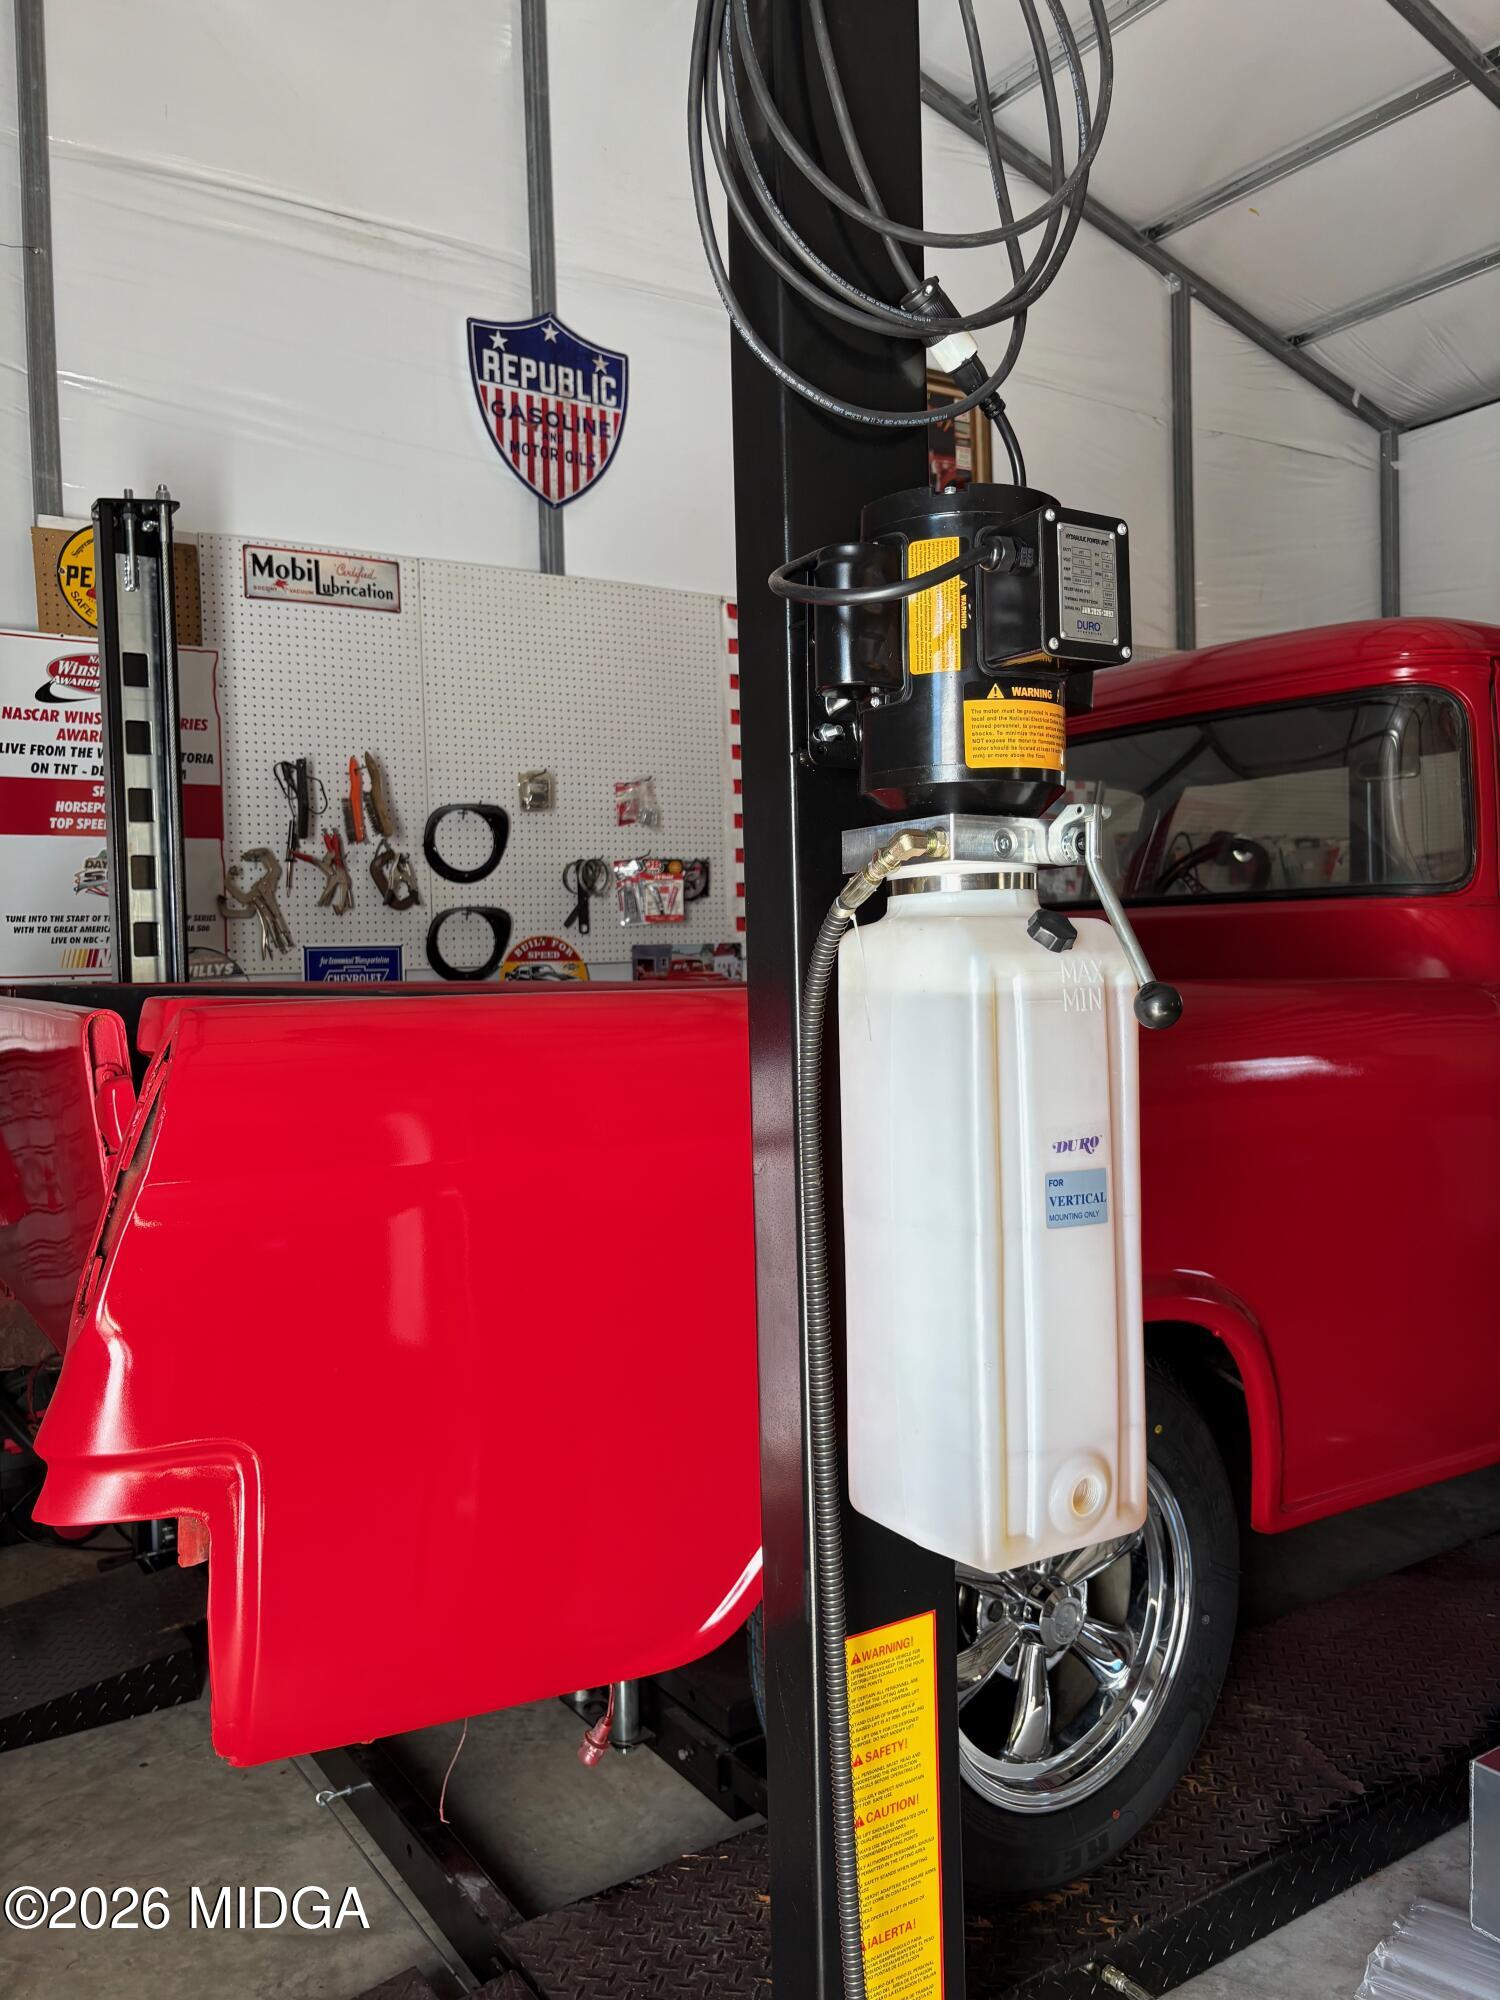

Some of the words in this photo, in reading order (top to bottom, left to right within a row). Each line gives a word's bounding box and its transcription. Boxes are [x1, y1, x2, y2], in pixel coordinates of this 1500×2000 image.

[482, 348, 617, 407] REPUBLIC
[491, 400, 611, 438] GASOLINE
[542, 433, 564, 444] AND
[510, 440, 559, 461] MOTOR
[565, 451, 596, 467] OILS
[71, 590, 95, 617] SAFE
[1077, 620, 1100, 632] DURO
[57, 660, 100, 677] Wins
[1011, 686, 1052, 699] WARNING
[2, 706, 60, 722] NASCAR
[64, 710, 103, 724] WINS
[180, 718, 208, 731] RIES
[56, 728, 103, 742] AWAR
[0, 743, 26, 754] LIVE
[30, 744, 66, 756] FROM
[71, 746, 93, 758] THE
[181, 753, 214, 764] TORIA
[31, 762, 49, 774] ON
[54, 763, 78, 775] TNT
[55, 801, 106, 814] HORSEP
[49, 817, 73, 829] TOP
[76, 818, 107, 830] SPEE
[6, 915, 26, 923] TUNE
[28, 915, 48, 923] INTO
[50, 915, 64, 923] THE
[66, 915, 90, 923] START
[92, 915, 102, 923] OF
[13, 926, 35, 934] WITH
[37, 926, 51, 934] THE
[514, 937, 546, 958] BUILT
[552, 939, 574, 958] FOR
[528, 951, 560, 959] SPEED
[327, 973, 382, 982] CHEVROLET
[1061, 960, 1104, 984] MAX
[1064, 988, 1101, 1012] MIN
[1053, 1135, 1100, 1154] DURO
[1048, 1179, 1064, 1187] FOR
[1049, 1192, 1107, 1207] VERTICAL
[1049, 1212, 1083, 1221] MOUNTING
[1084, 1210, 1100, 1218] ONLY
[861, 1637, 914, 1661] WARNING!
[865, 1738, 908, 1763] SAFETY!
[866, 1794, 919, 1823] CAUTION!
